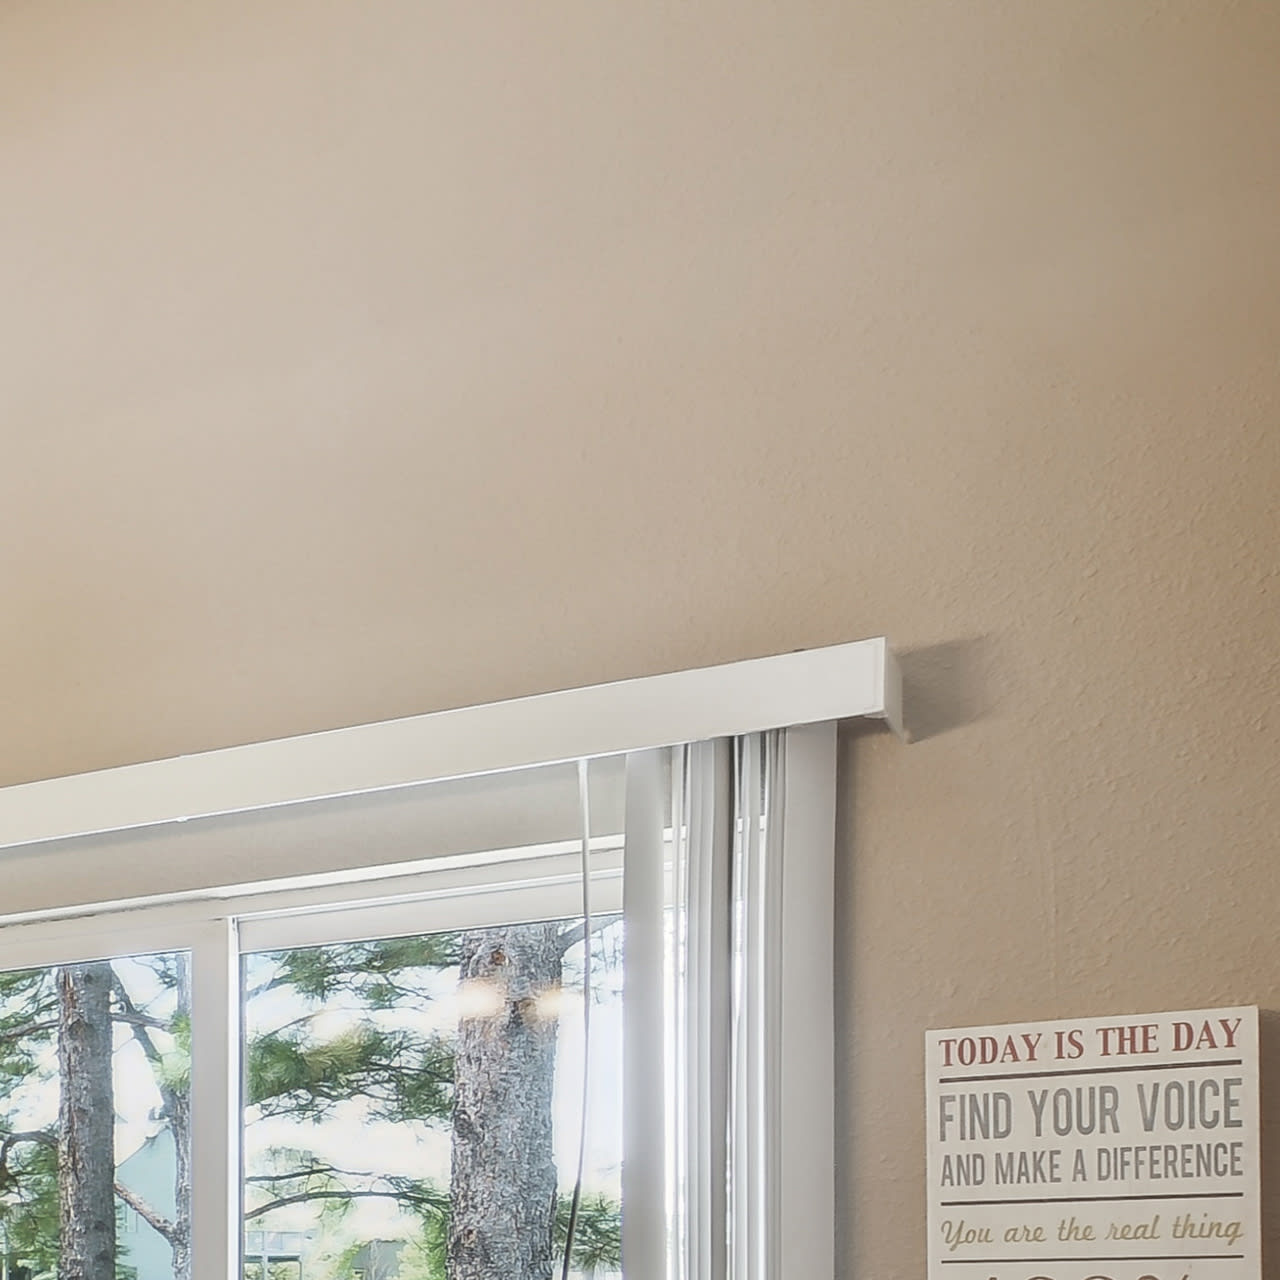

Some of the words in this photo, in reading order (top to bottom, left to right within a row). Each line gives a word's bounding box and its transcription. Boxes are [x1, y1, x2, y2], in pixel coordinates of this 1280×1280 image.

[938, 1033, 1042, 1067] TODAY
[1054, 1030, 1085, 1059] IS
[1096, 1024, 1159, 1056] THE
[1171, 1018, 1242, 1051] DAY
[940, 1091, 1012, 1142] FIND
[1027, 1084, 1120, 1137] YOUR
[1137, 1077, 1243, 1132] VOICE
[940, 1153, 985, 1187] AND
[995, 1150, 1062, 1184] MAKE
[1071, 1149, 1088, 1181] A
[1097, 1142, 1243, 1181] DIFFERENCE
[941, 1219, 993, 1251] You
[1004, 1225, 1046, 1243] are
[1057, 1216, 1096, 1242] the
[1104, 1214, 1160, 1240] real
[1171, 1212, 1244, 1246] thing
